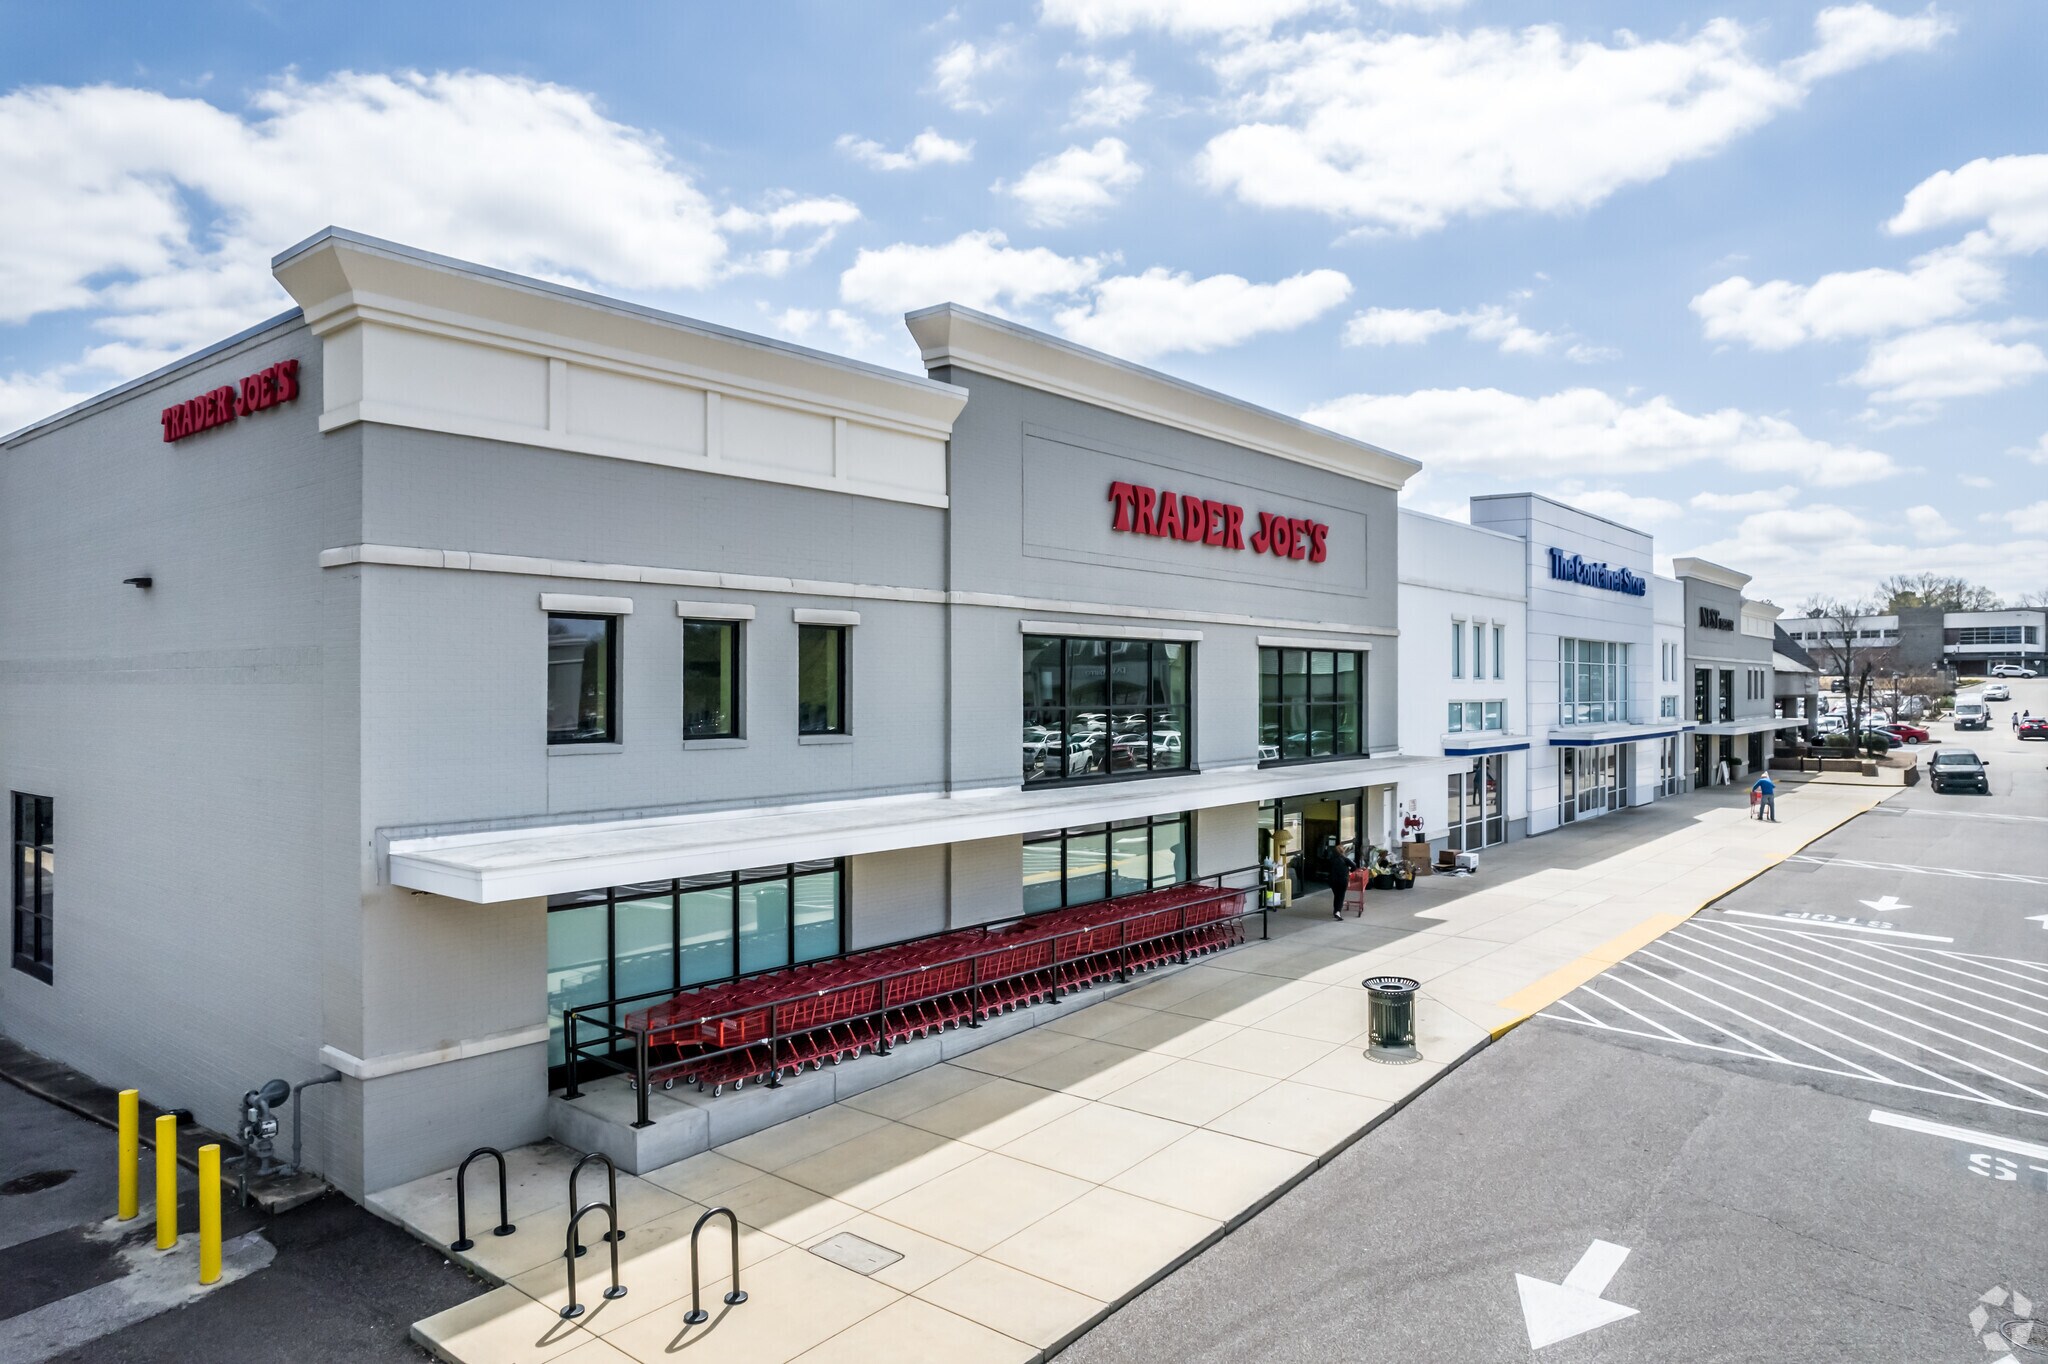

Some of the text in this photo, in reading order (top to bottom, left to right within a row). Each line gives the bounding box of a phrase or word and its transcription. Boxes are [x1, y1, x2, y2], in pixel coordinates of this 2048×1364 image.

[161, 359, 299, 443] TRADER JOE'S
[1108, 481, 1330, 563] TRADER JOE'S
[1549, 547, 1646, 597] The Container Store
[1784, 912, 1894, 930] STOP
